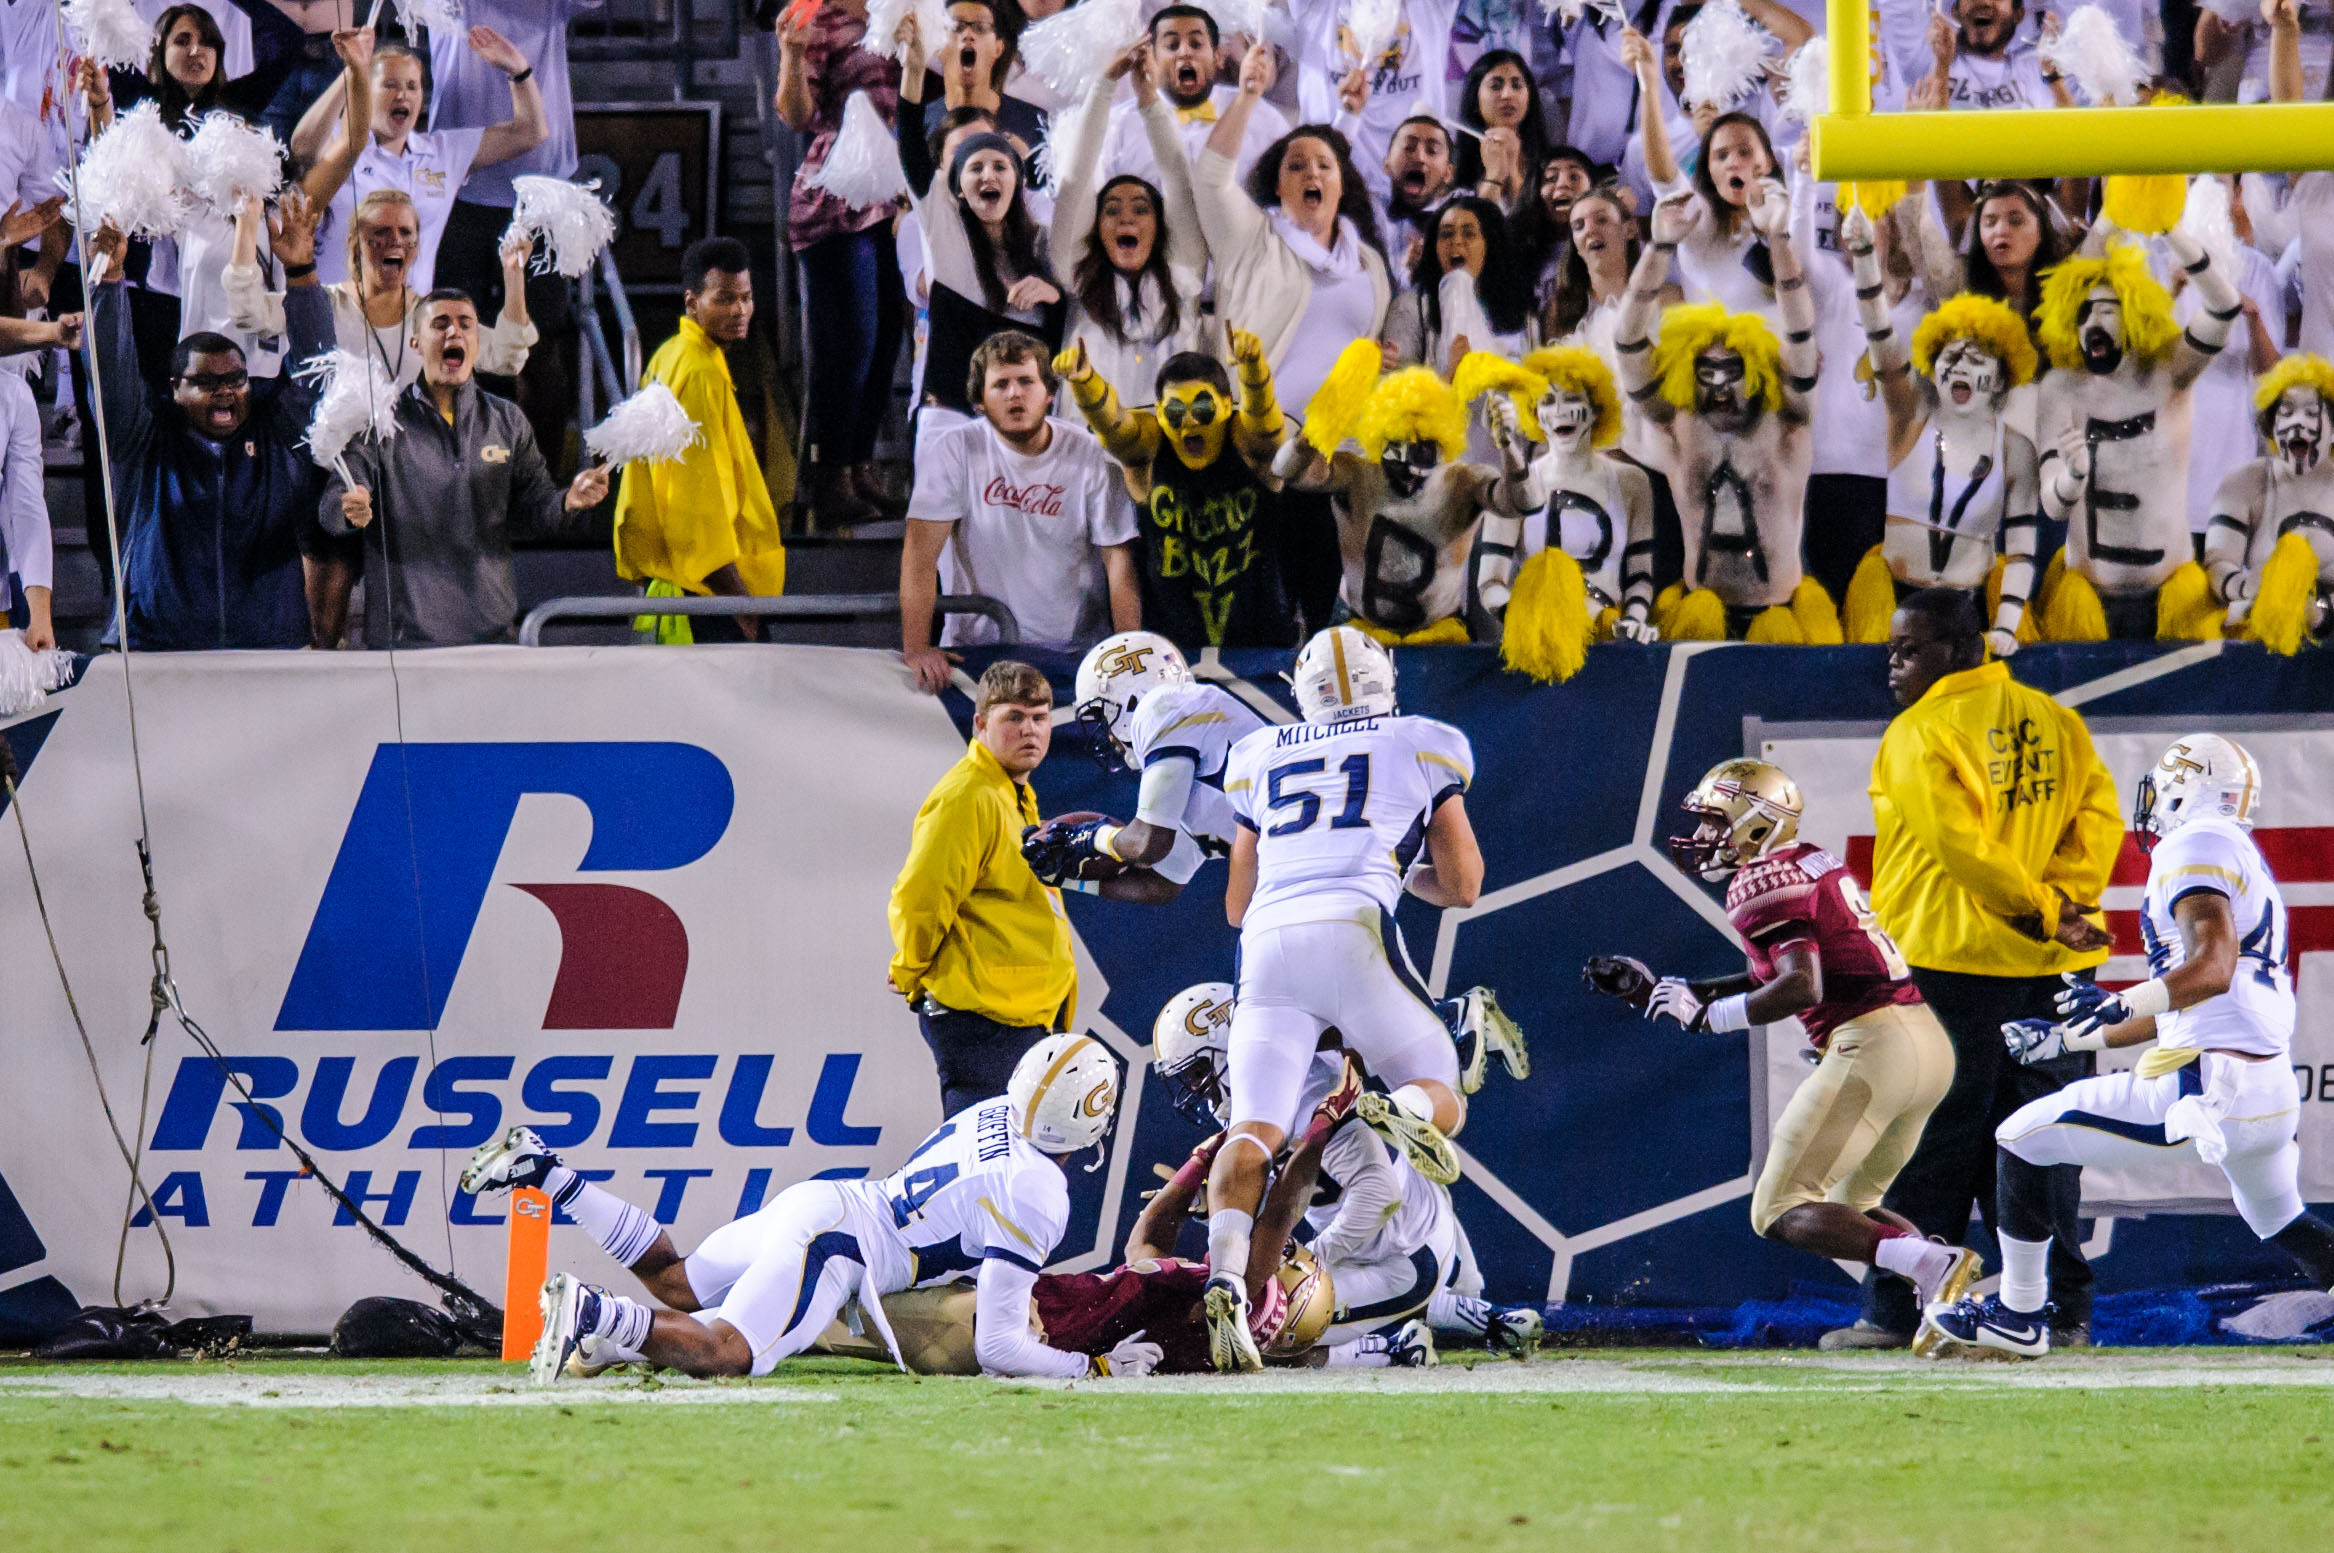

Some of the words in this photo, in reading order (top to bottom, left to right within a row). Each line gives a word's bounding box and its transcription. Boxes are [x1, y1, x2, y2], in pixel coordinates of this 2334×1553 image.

[1696, 455, 1769, 584] A
[1928, 428, 1994, 574] V
[2085, 410, 2165, 566] E
[1362, 513, 1438, 635] B
[1333, 705, 1370, 720] JACKETS
[1267, 752, 1373, 839] 51
[149, 1053, 882, 1151] RUSSELL
[976, 1100, 1010, 1163] GRIFFIN
[129, 1168, 871, 1228] ATHLTI
[514, 1197, 547, 1219] GT
